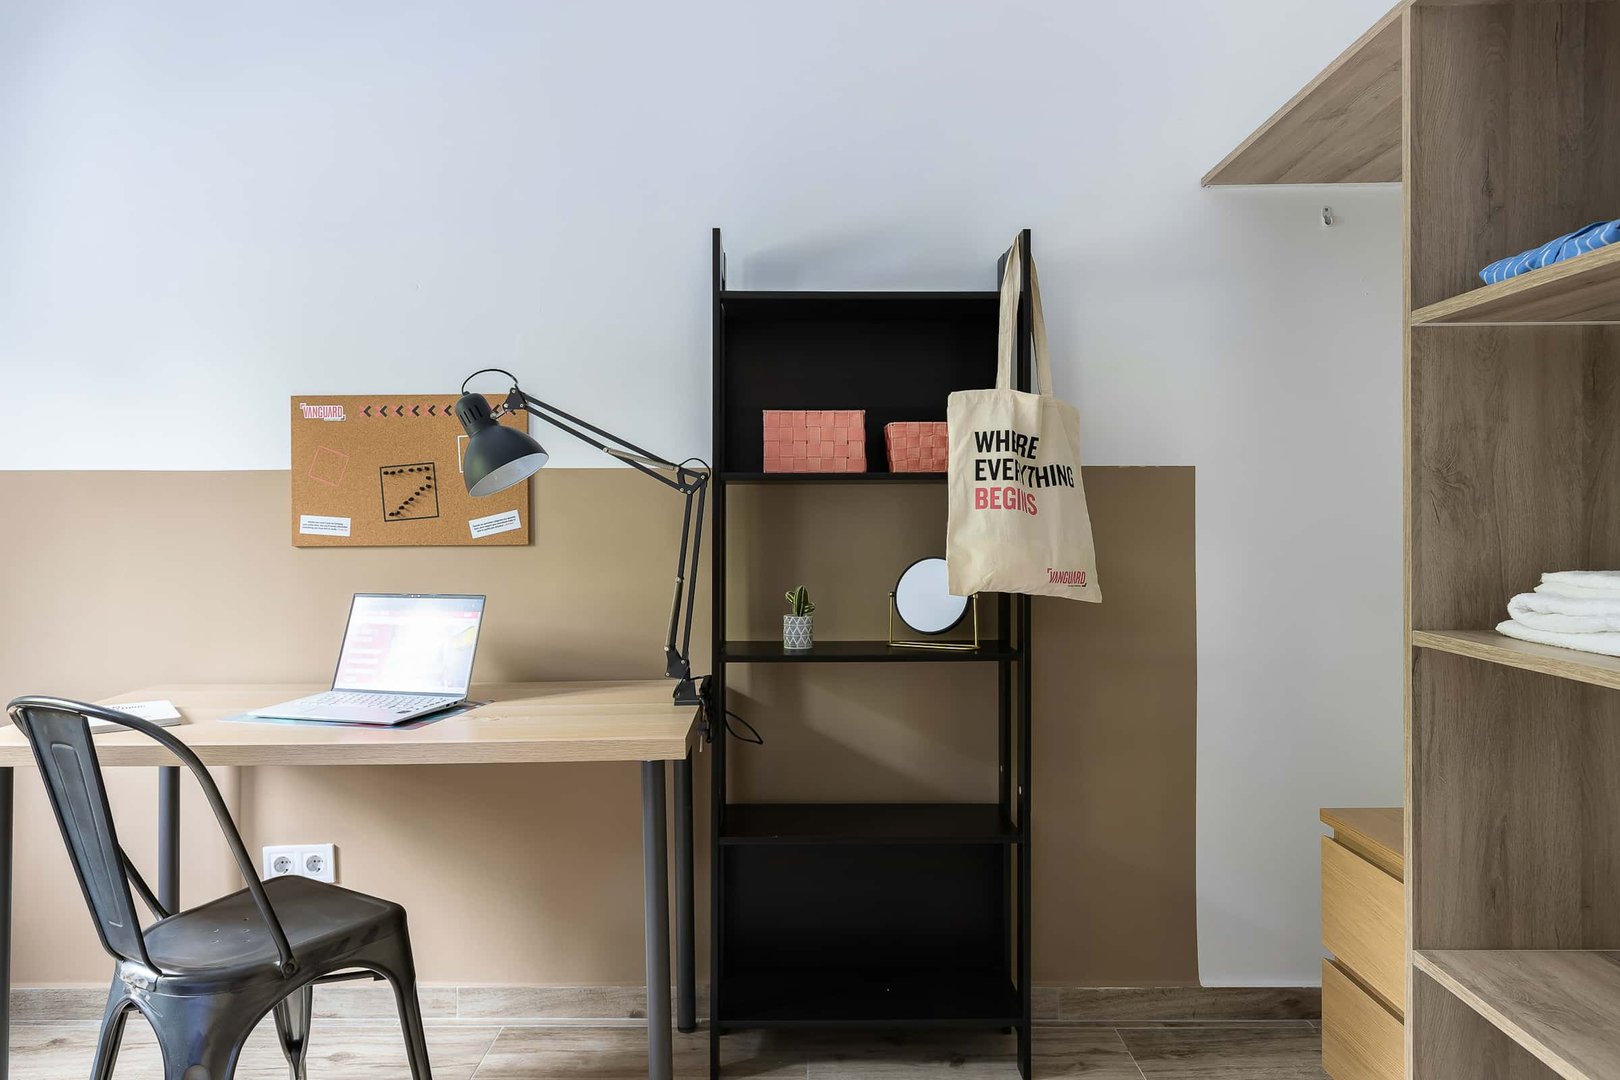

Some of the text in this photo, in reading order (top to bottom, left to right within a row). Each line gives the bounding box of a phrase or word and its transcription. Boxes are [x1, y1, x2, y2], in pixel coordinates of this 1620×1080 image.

[303, 406, 343, 418] VANGUARD
[975, 430, 1039, 459] WHERE
[975, 486, 1038, 515] BEGINS
[1049, 571, 1086, 584] VANGUARD
